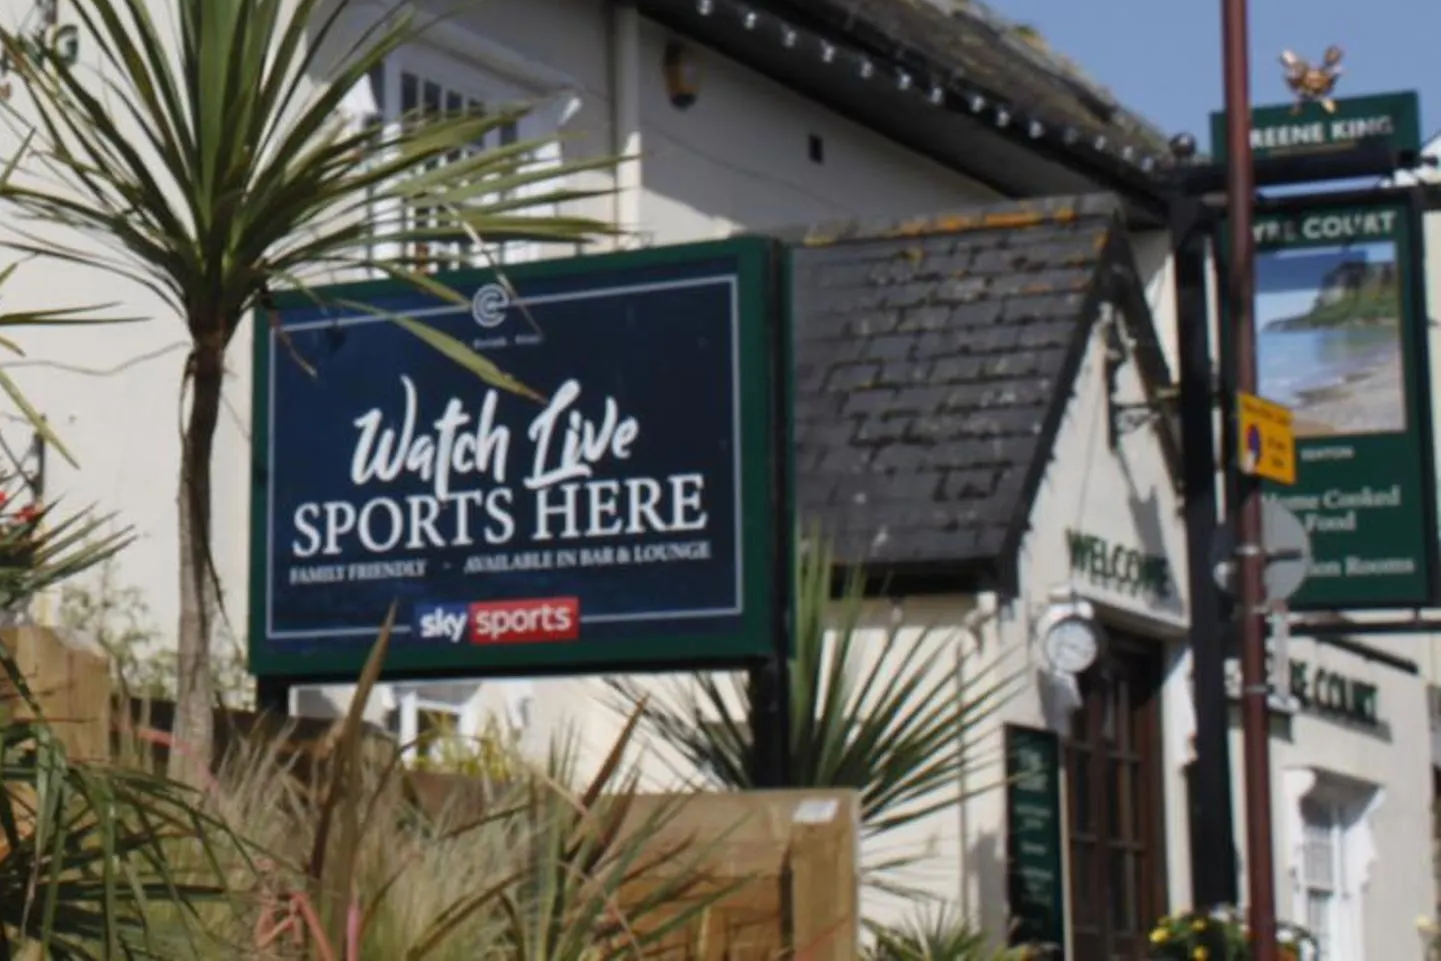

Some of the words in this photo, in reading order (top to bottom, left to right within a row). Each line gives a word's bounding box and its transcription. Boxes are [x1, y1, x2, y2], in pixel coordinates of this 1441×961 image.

[1249, 122, 1323, 148] REENE
[1331, 115, 1394, 140] KING
[1302, 210, 1397, 239] COURT
[350, 374, 510, 501] Watch
[524, 378, 639, 489] Live
[292, 488, 515, 557] SPORTS
[533, 473, 707, 540] HERE
[1305, 511, 1356, 532] Food
[289, 565, 344, 585] FAMILY
[348, 559, 426, 581] FRIENDLY
[464, 551, 552, 573] AVAILABLE
[558, 549, 577, 568] IN
[580, 545, 614, 566] BAR
[634, 540, 710, 563] LOUNGE
[420, 607, 467, 643] sky
[476, 604, 573, 639] sports
